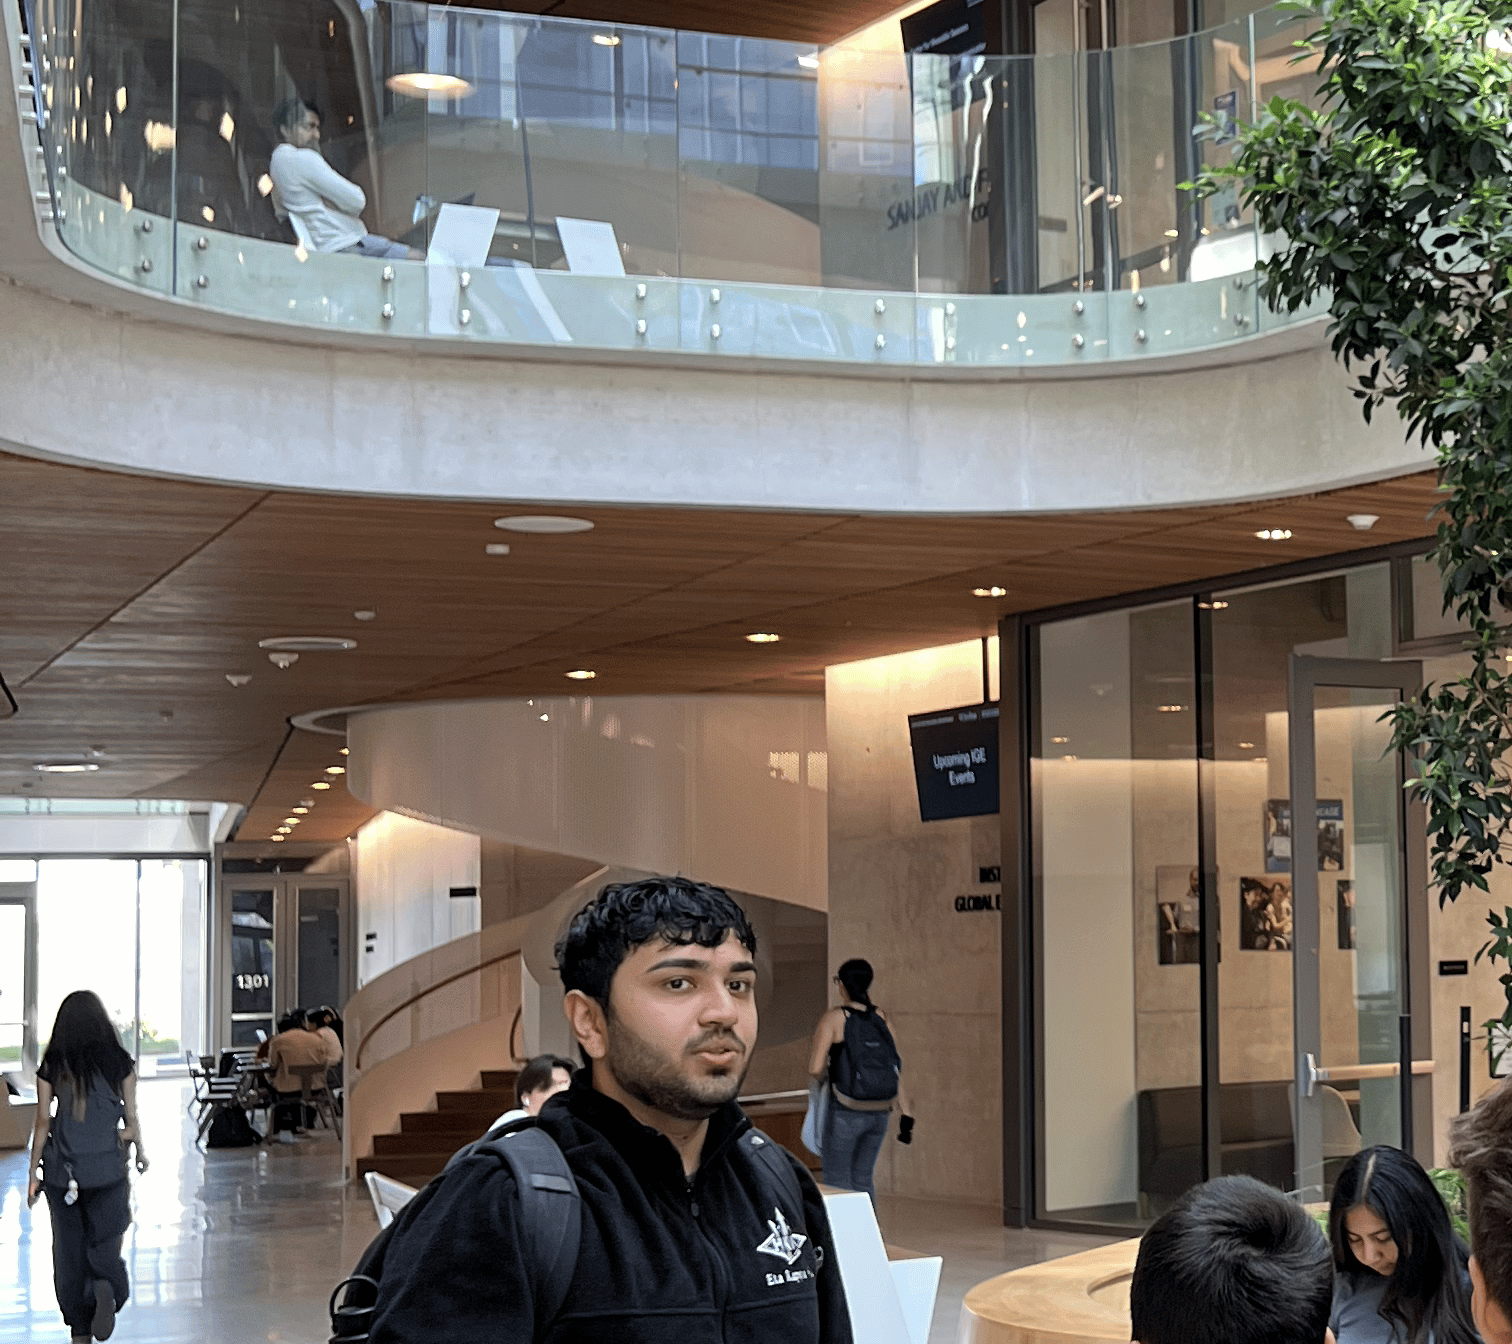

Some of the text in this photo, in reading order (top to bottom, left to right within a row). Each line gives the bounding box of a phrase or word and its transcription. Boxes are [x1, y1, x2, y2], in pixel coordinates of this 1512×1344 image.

[932, 751, 970, 771] Upcoming
[948, 770, 976, 787] Events
[955, 895, 994, 913] GLOBAL
[236, 973, 269, 990] 1301
